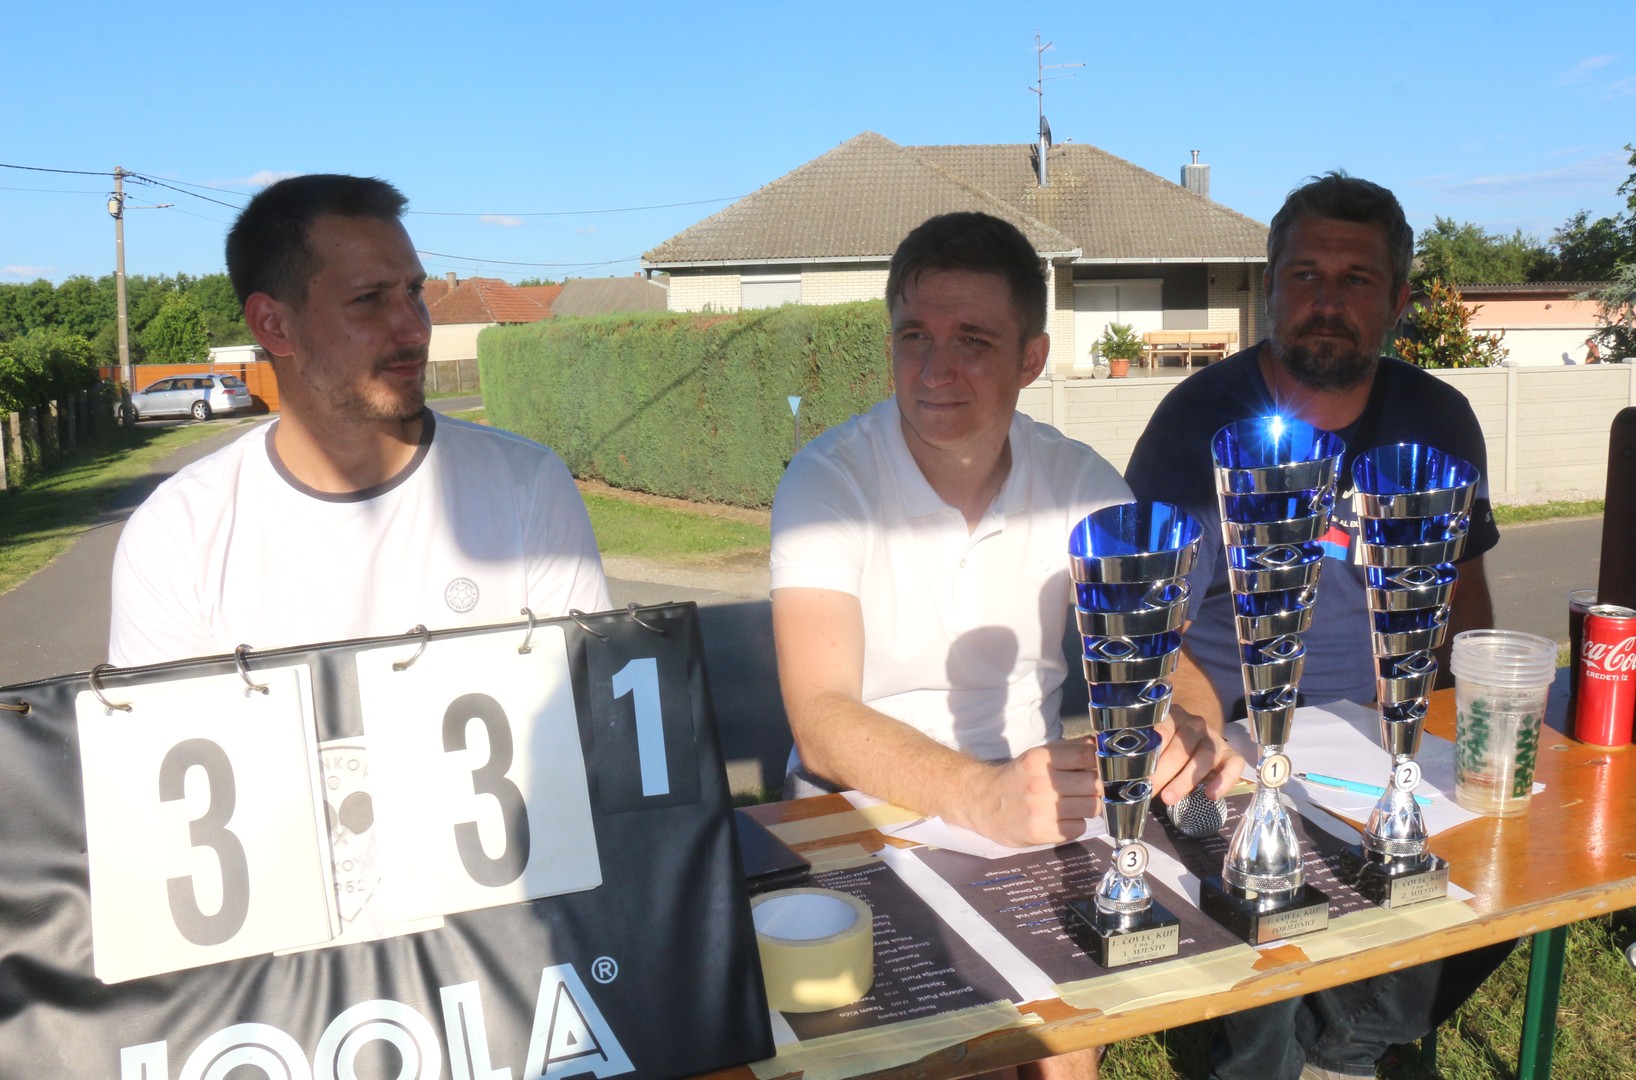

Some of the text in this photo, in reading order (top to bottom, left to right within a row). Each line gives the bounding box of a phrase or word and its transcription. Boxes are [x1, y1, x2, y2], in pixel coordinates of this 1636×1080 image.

[1586, 670, 1619, 681] EREDETI
[611, 657, 670, 798] 1
[1270, 762, 1278, 778] 1
[1402, 768, 1413, 784] 2
[441, 692, 532, 890] 3
[158, 738, 251, 946] 3
[1126, 850, 1138, 868] 3
[984, 869, 1010, 877] Omega
[1006, 887, 1032, 896] Omega
[872, 928, 897, 936] Panad
[1271, 918, 1316, 935] POBJEDNICI
[1155, 929, 1176, 939] KUP
[1132, 943, 1166, 956] MJESTO
[884, 953, 920, 964] Panadon
[911, 960, 934, 970] Team
[921, 966, 956, 979] Stolarija
[908, 980, 947, 992] Zajebanti
[939, 985, 974, 999] Stolarija
[860, 1004, 884, 1014] Team
